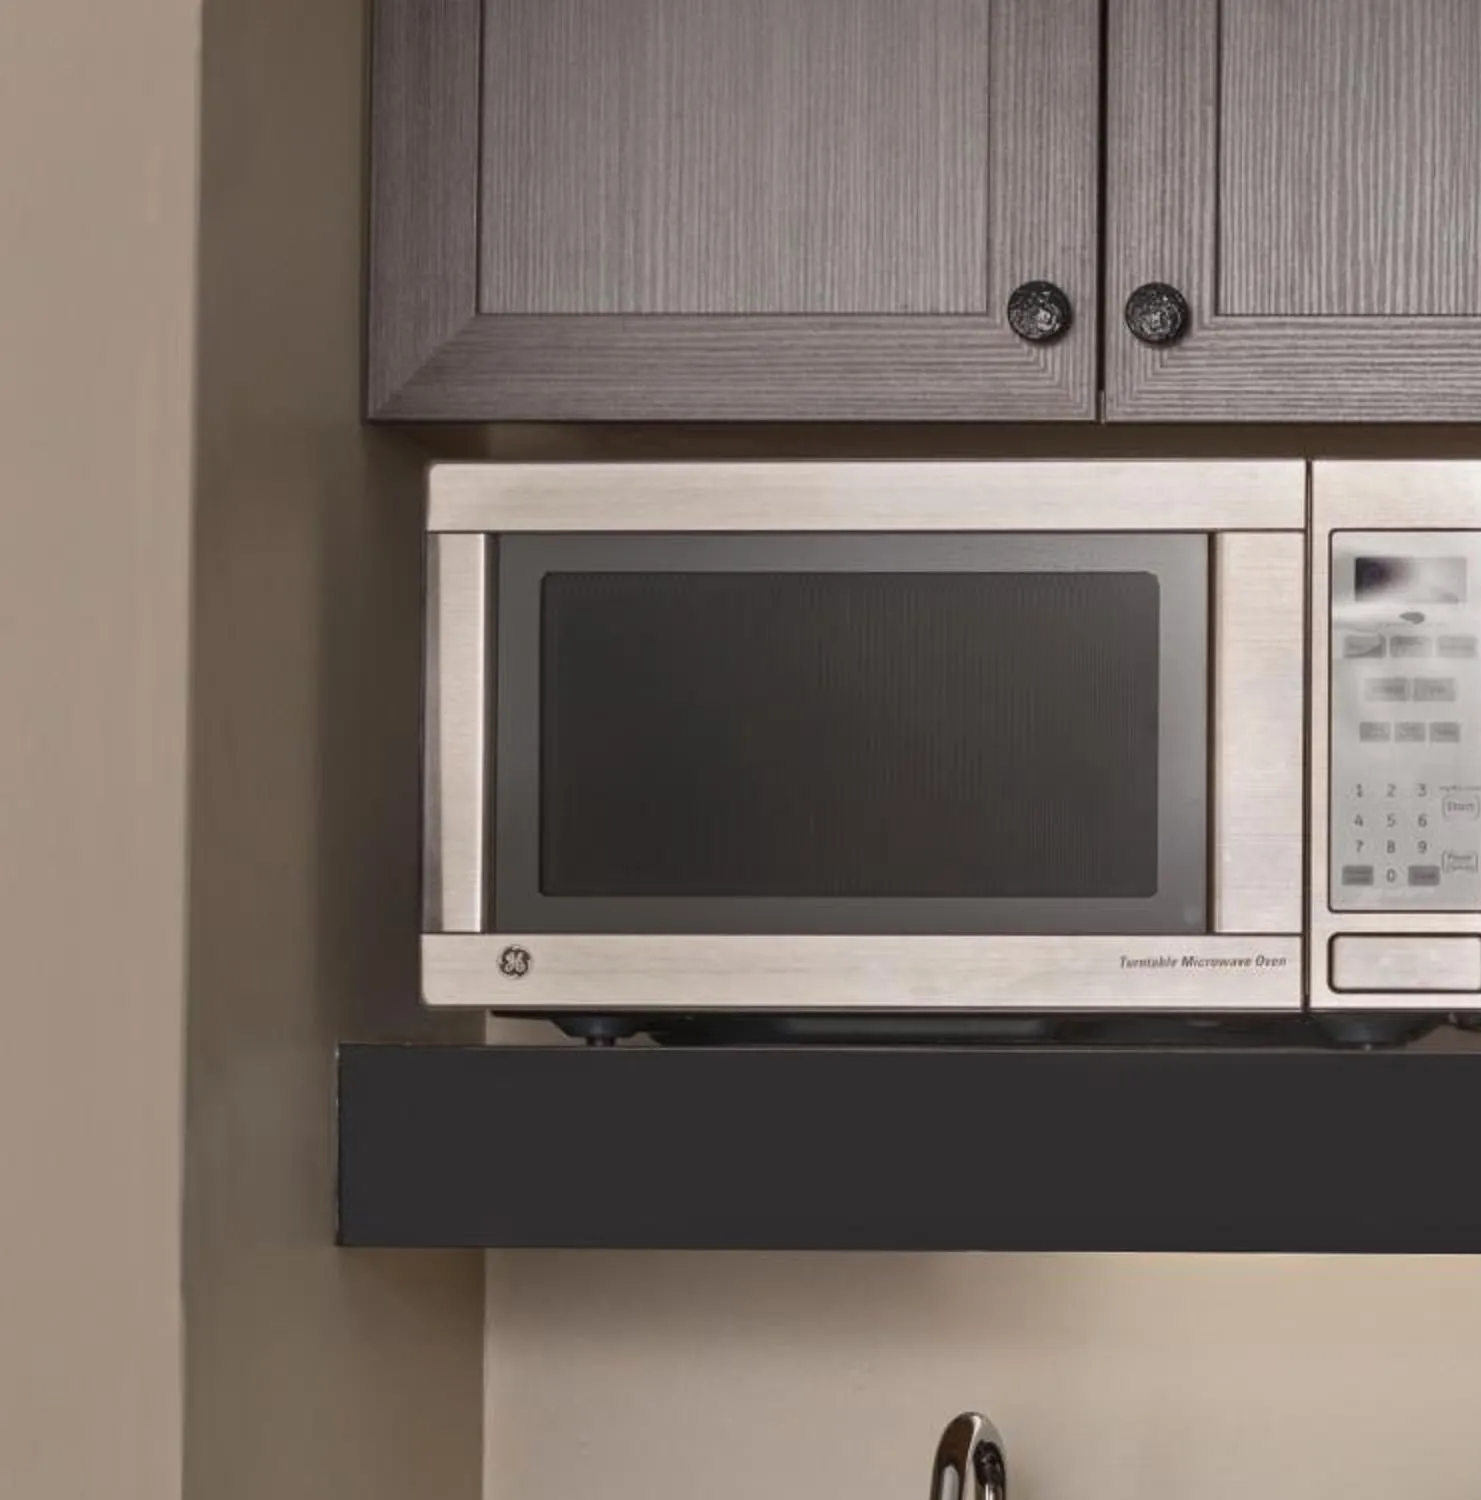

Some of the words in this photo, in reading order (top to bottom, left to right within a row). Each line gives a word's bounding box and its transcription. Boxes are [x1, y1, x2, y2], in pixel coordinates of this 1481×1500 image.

[1355, 783, 1364, 798] 1
[1386, 783, 1397, 798] 2
[1417, 783, 1428, 798] 3
[1353, 814, 1364, 828] 4
[1386, 814, 1397, 828] 5
[1417, 814, 1428, 828] 6
[1354, 840, 1364, 854] 7
[1386, 840, 1396, 854] 8
[1417, 840, 1428, 854] 9
[1385, 868, 1396, 883] 0
[1119, 955, 1178, 969] Turntable
[1181, 955, 1251, 968] Microwave
[1255, 954, 1287, 967] Oven
